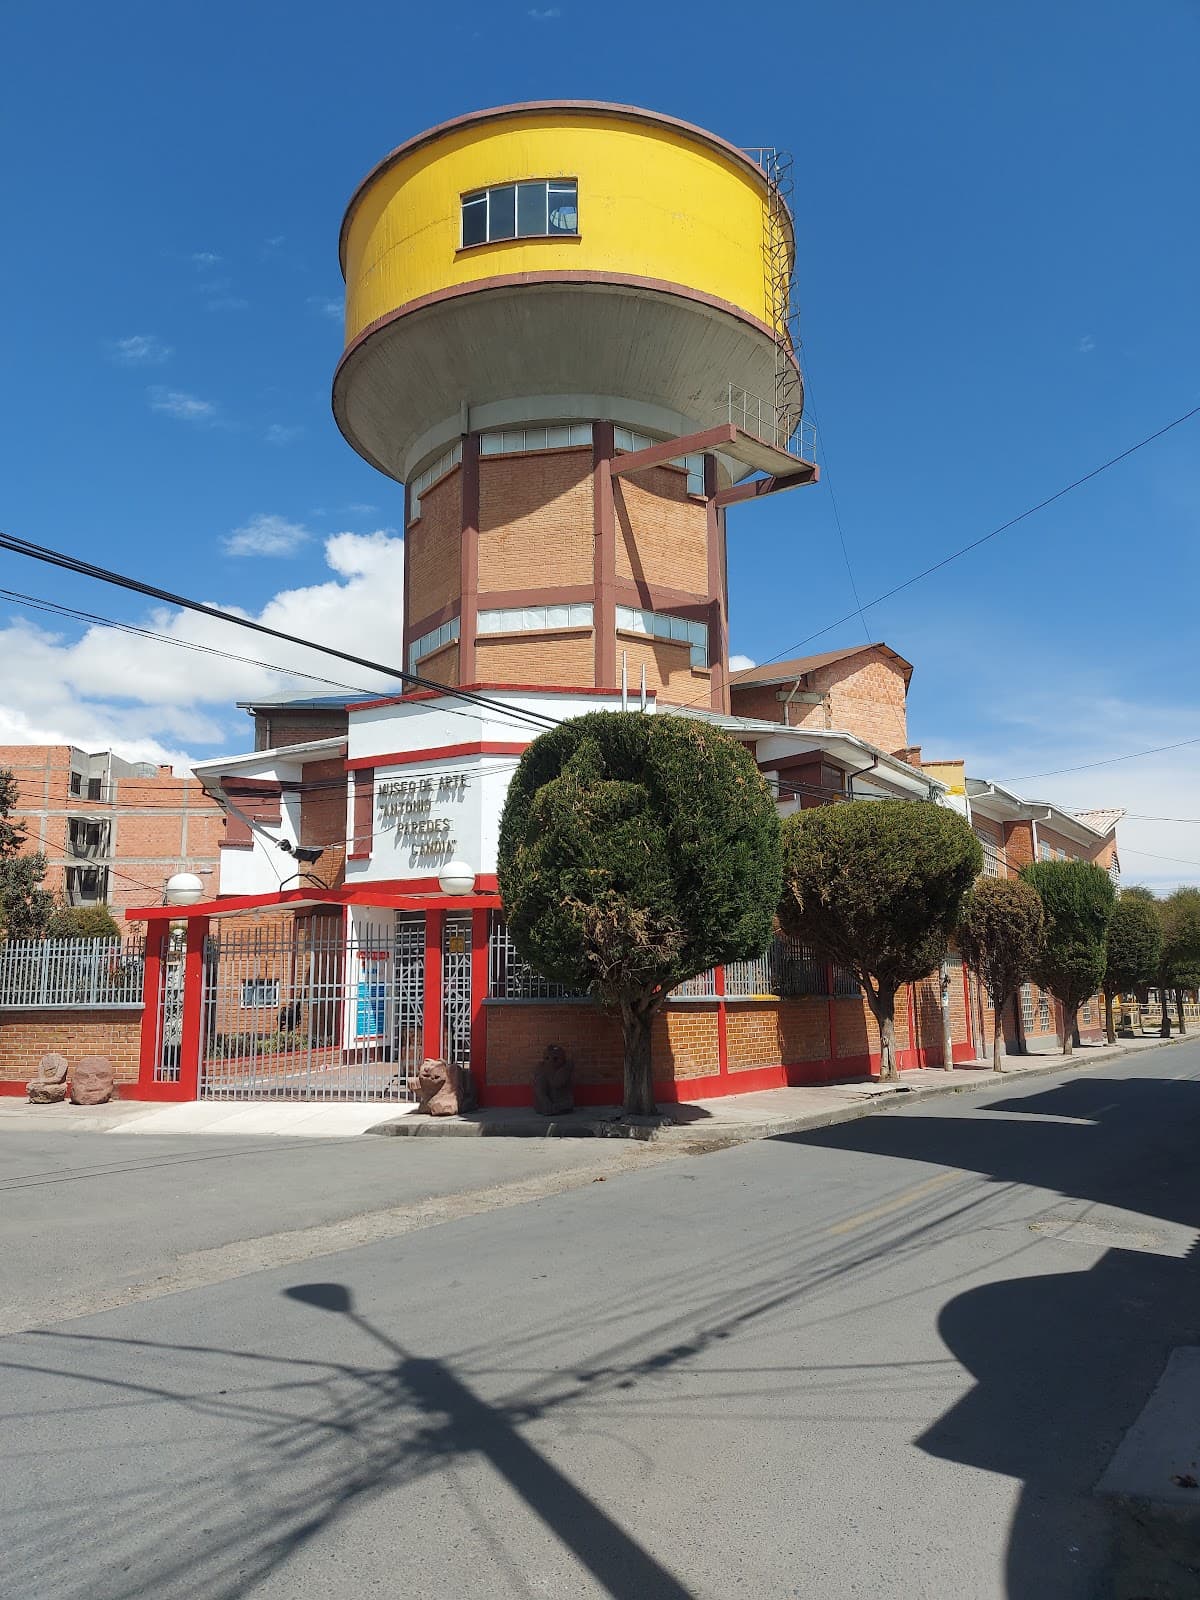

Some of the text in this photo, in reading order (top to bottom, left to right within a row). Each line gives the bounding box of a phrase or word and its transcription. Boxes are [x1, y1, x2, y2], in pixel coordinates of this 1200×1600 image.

[378, 774, 468, 796] MUSEO DE ARTE
[397, 818, 450, 835] PAREDES
